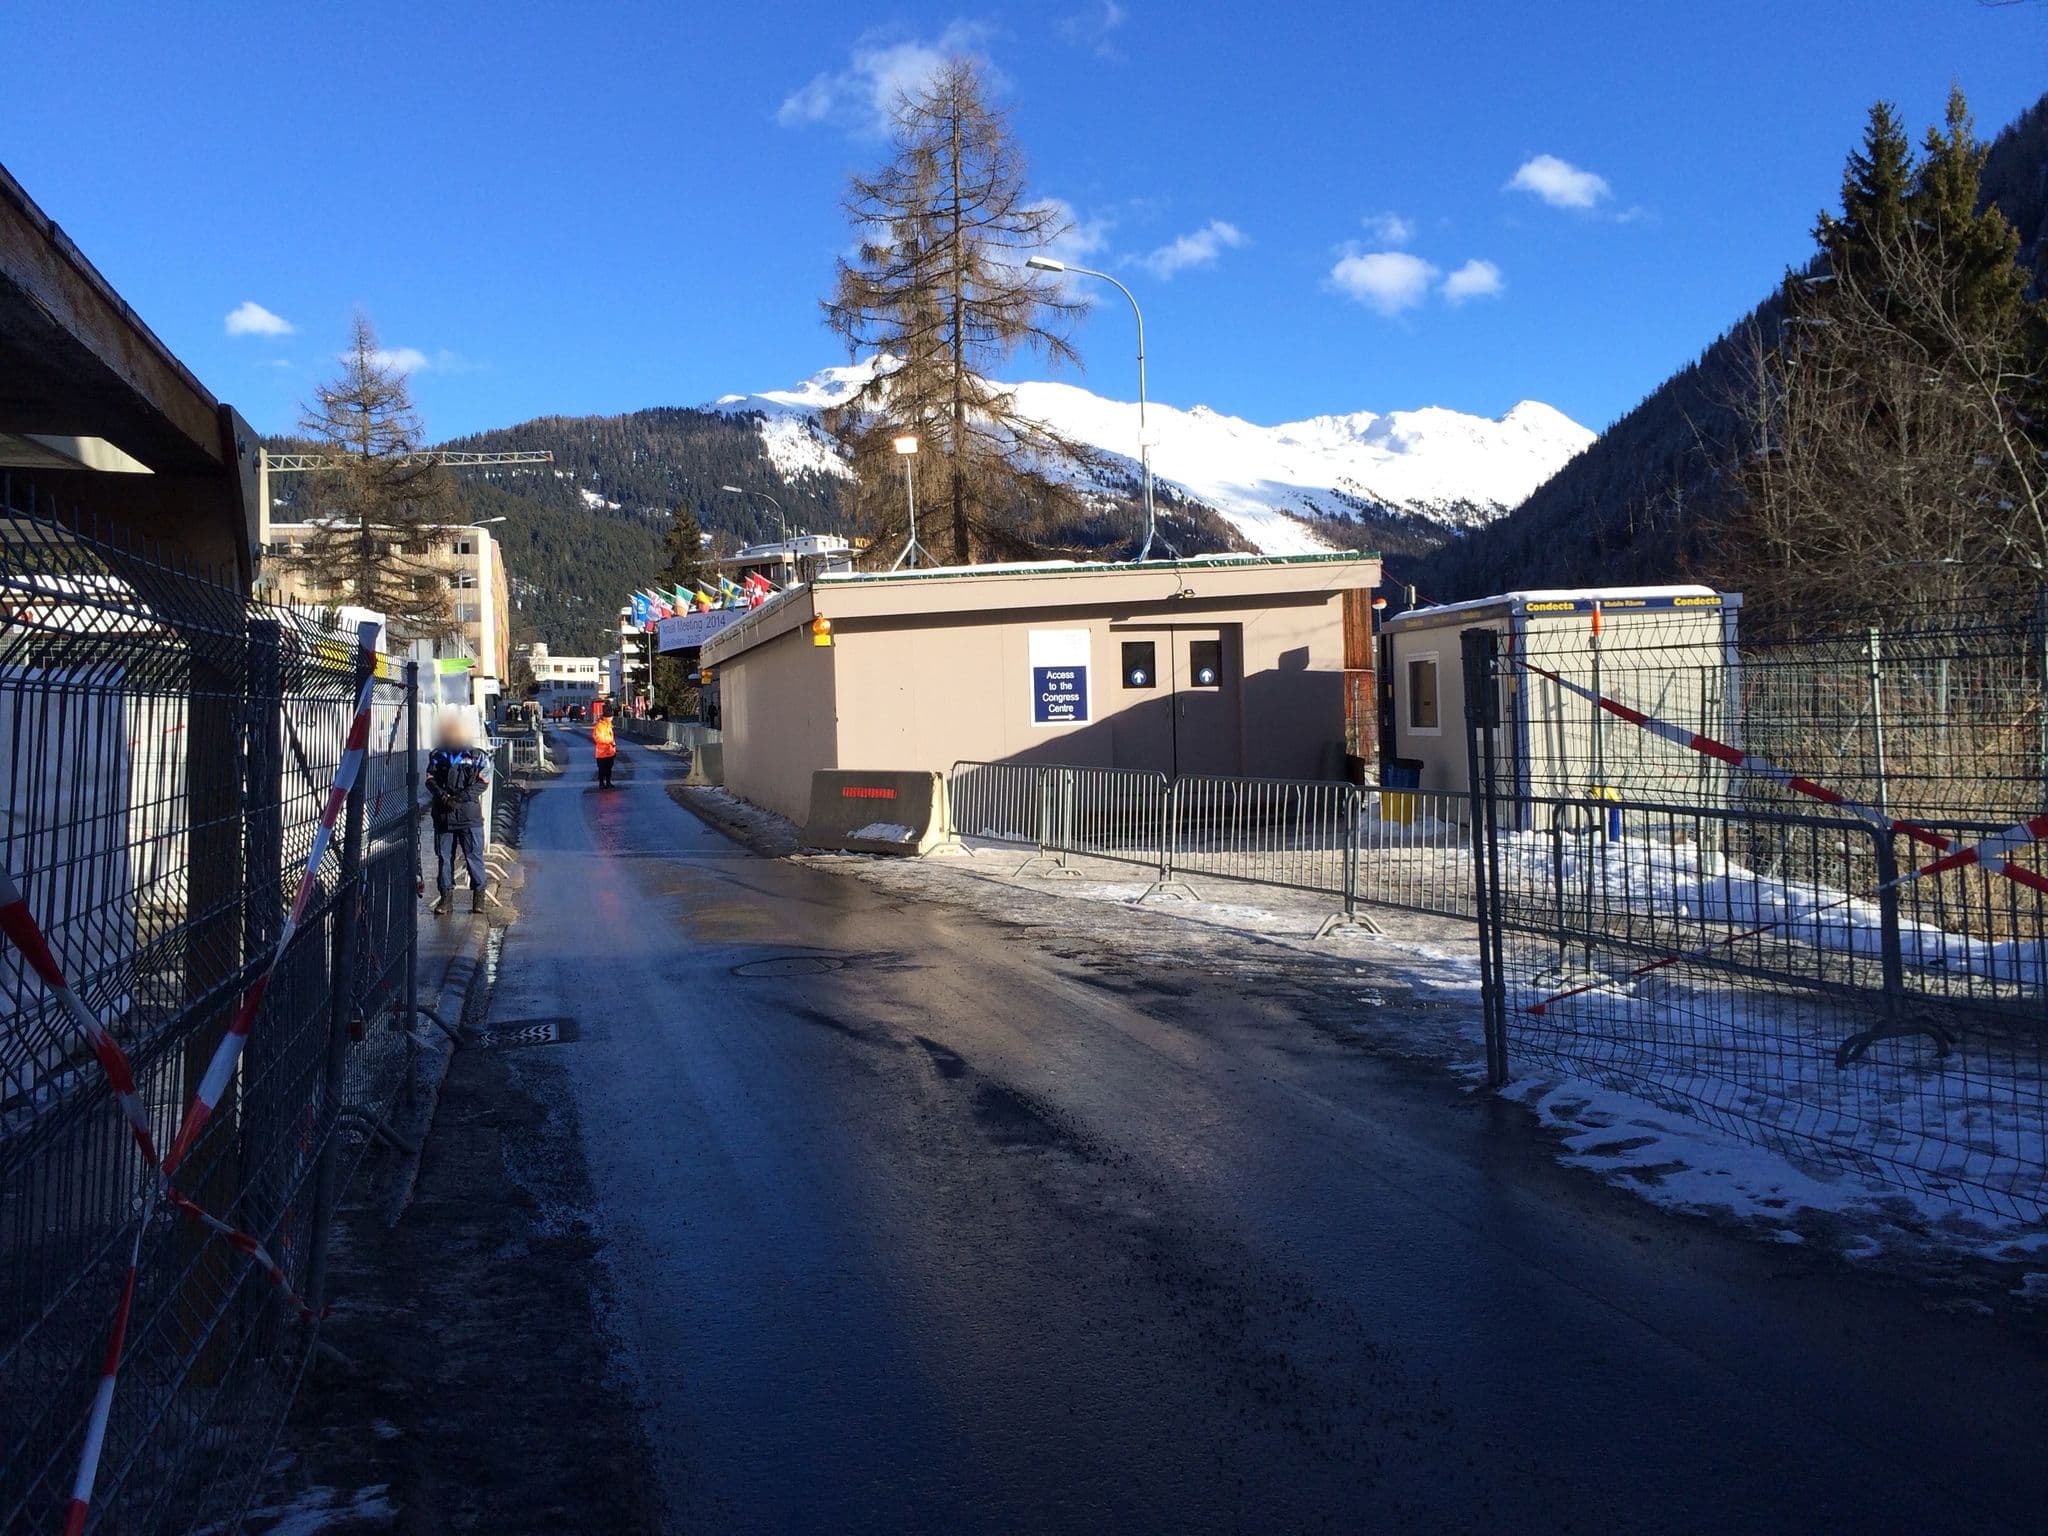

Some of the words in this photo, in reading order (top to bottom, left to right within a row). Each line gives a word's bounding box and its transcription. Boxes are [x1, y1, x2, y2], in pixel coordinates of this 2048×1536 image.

[1526, 602, 1574, 611] Condecta
[1673, 596, 1721, 606] Condecta
[678, 617, 703, 632] Meeting
[706, 614, 726, 629] 2014
[1046, 671, 1075, 680] Access
[1048, 682, 1057, 691] to
[1060, 681, 1073, 690] the
[1042, 692, 1080, 703] Congress
[1048, 703, 1074, 713] Centre
